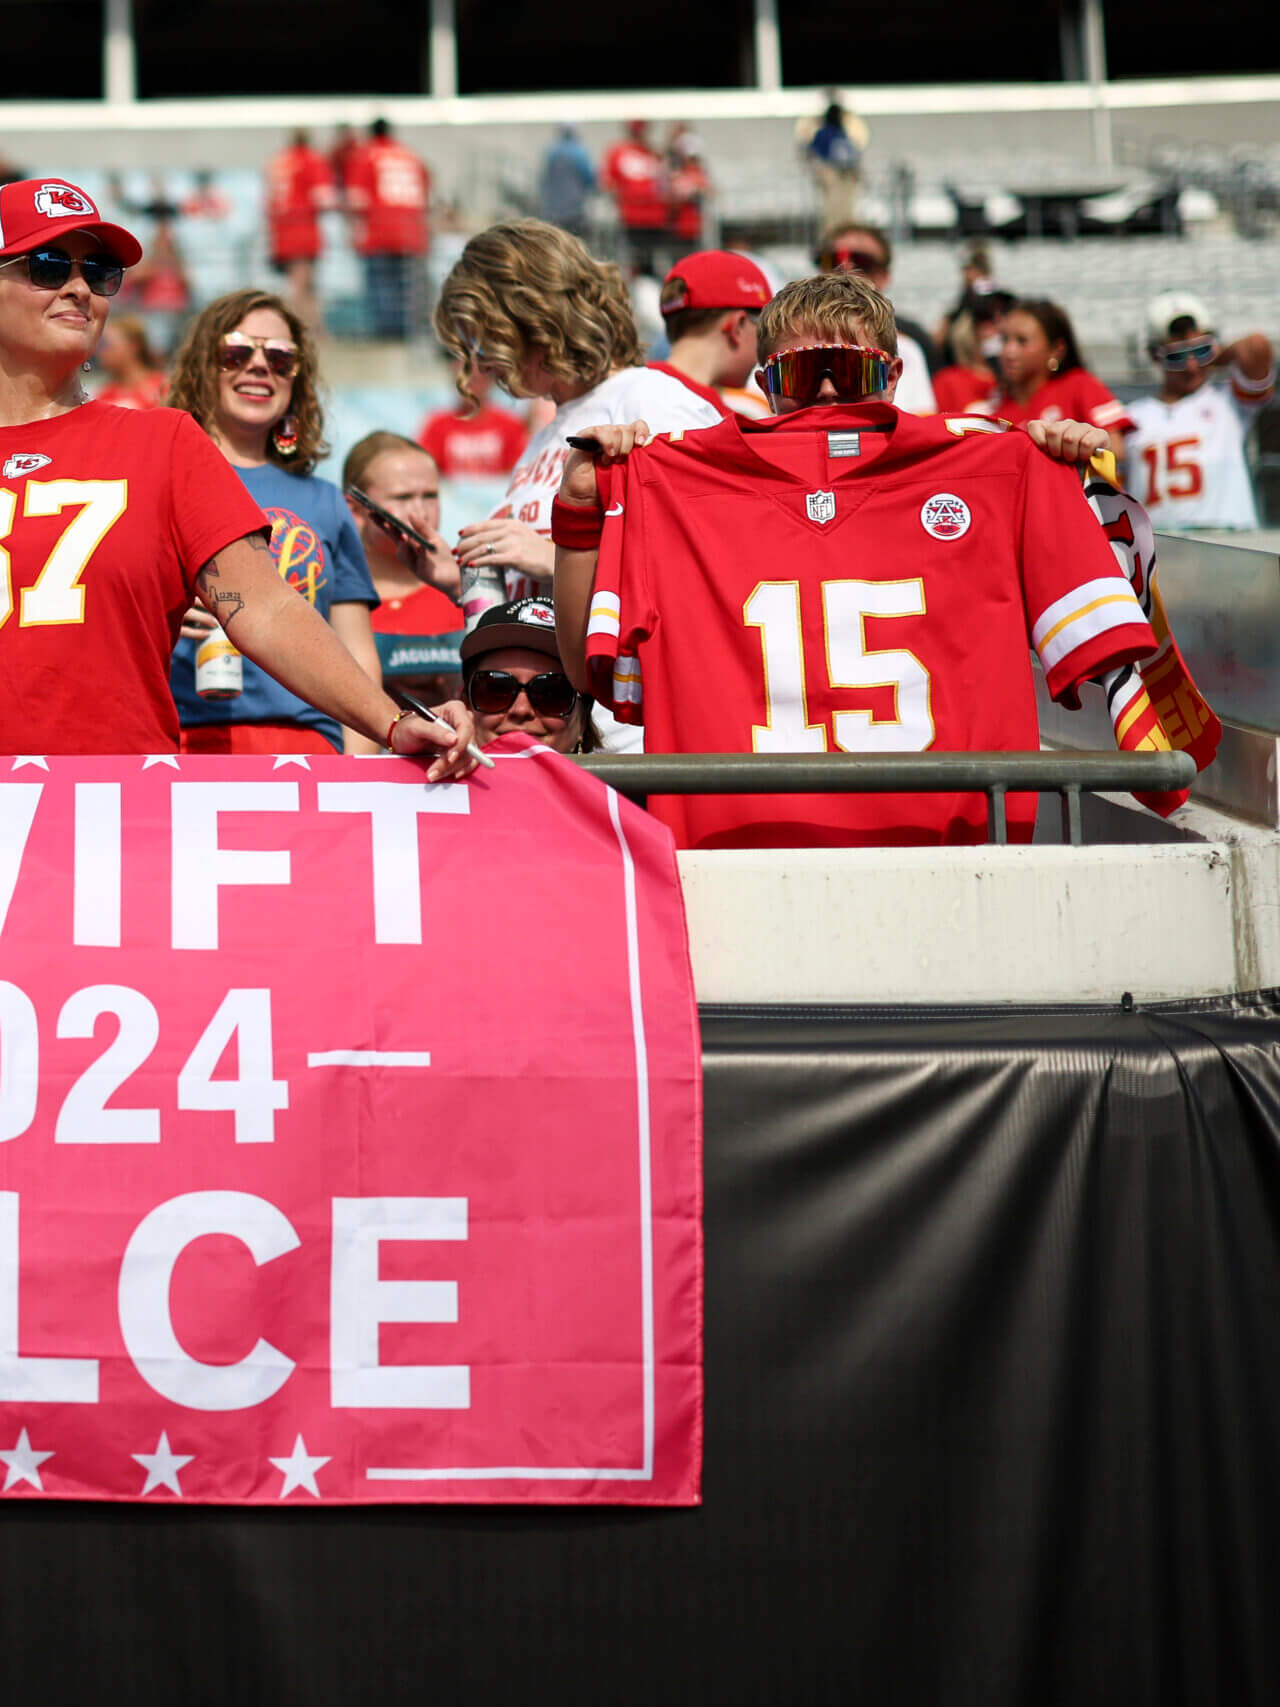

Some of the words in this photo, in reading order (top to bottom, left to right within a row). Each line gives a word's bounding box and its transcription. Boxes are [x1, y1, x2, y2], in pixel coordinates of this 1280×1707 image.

[1141, 438, 1203, 506] 15
[811, 504, 833, 518] NFL
[743, 577, 936, 753] 15
